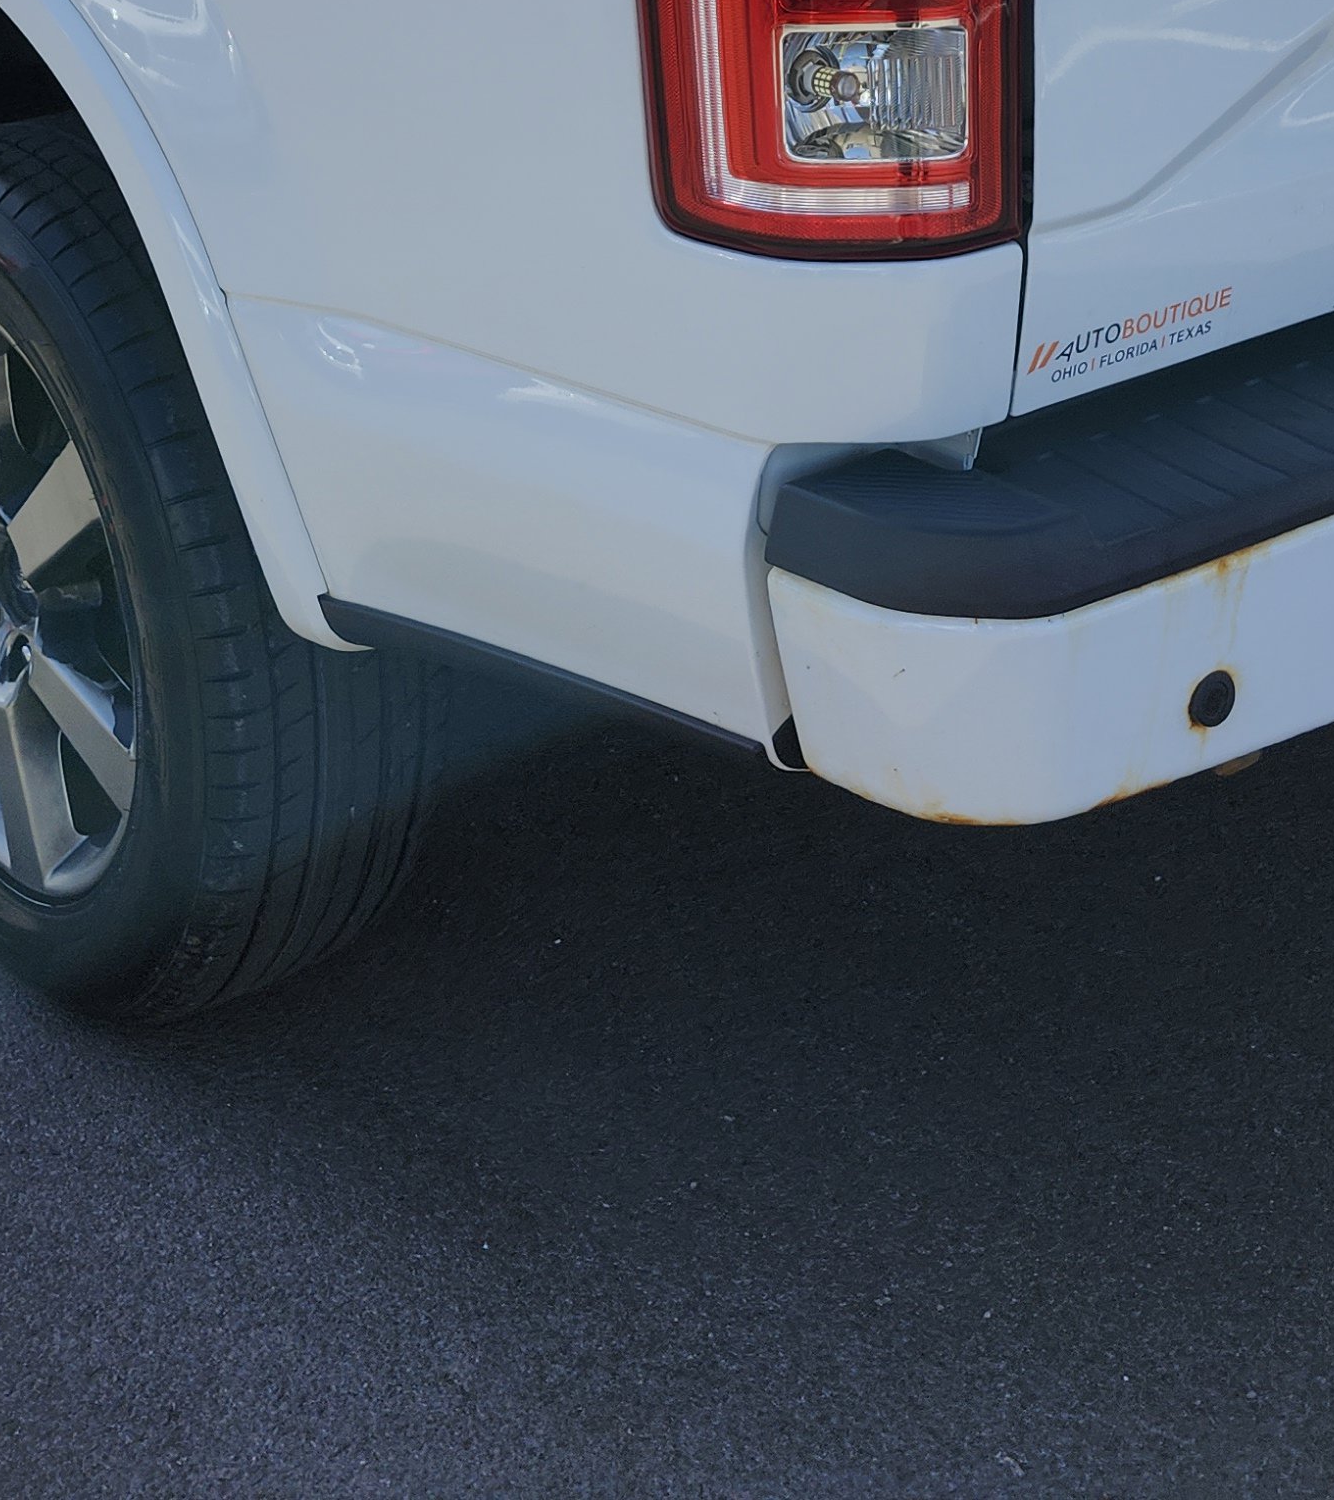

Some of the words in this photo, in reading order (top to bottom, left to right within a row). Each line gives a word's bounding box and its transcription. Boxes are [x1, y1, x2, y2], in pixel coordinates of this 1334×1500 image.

[1051, 361, 1088, 383] OHIO
[1098, 340, 1158, 368] FLORIDA
[1168, 320, 1212, 347] TEXAS
